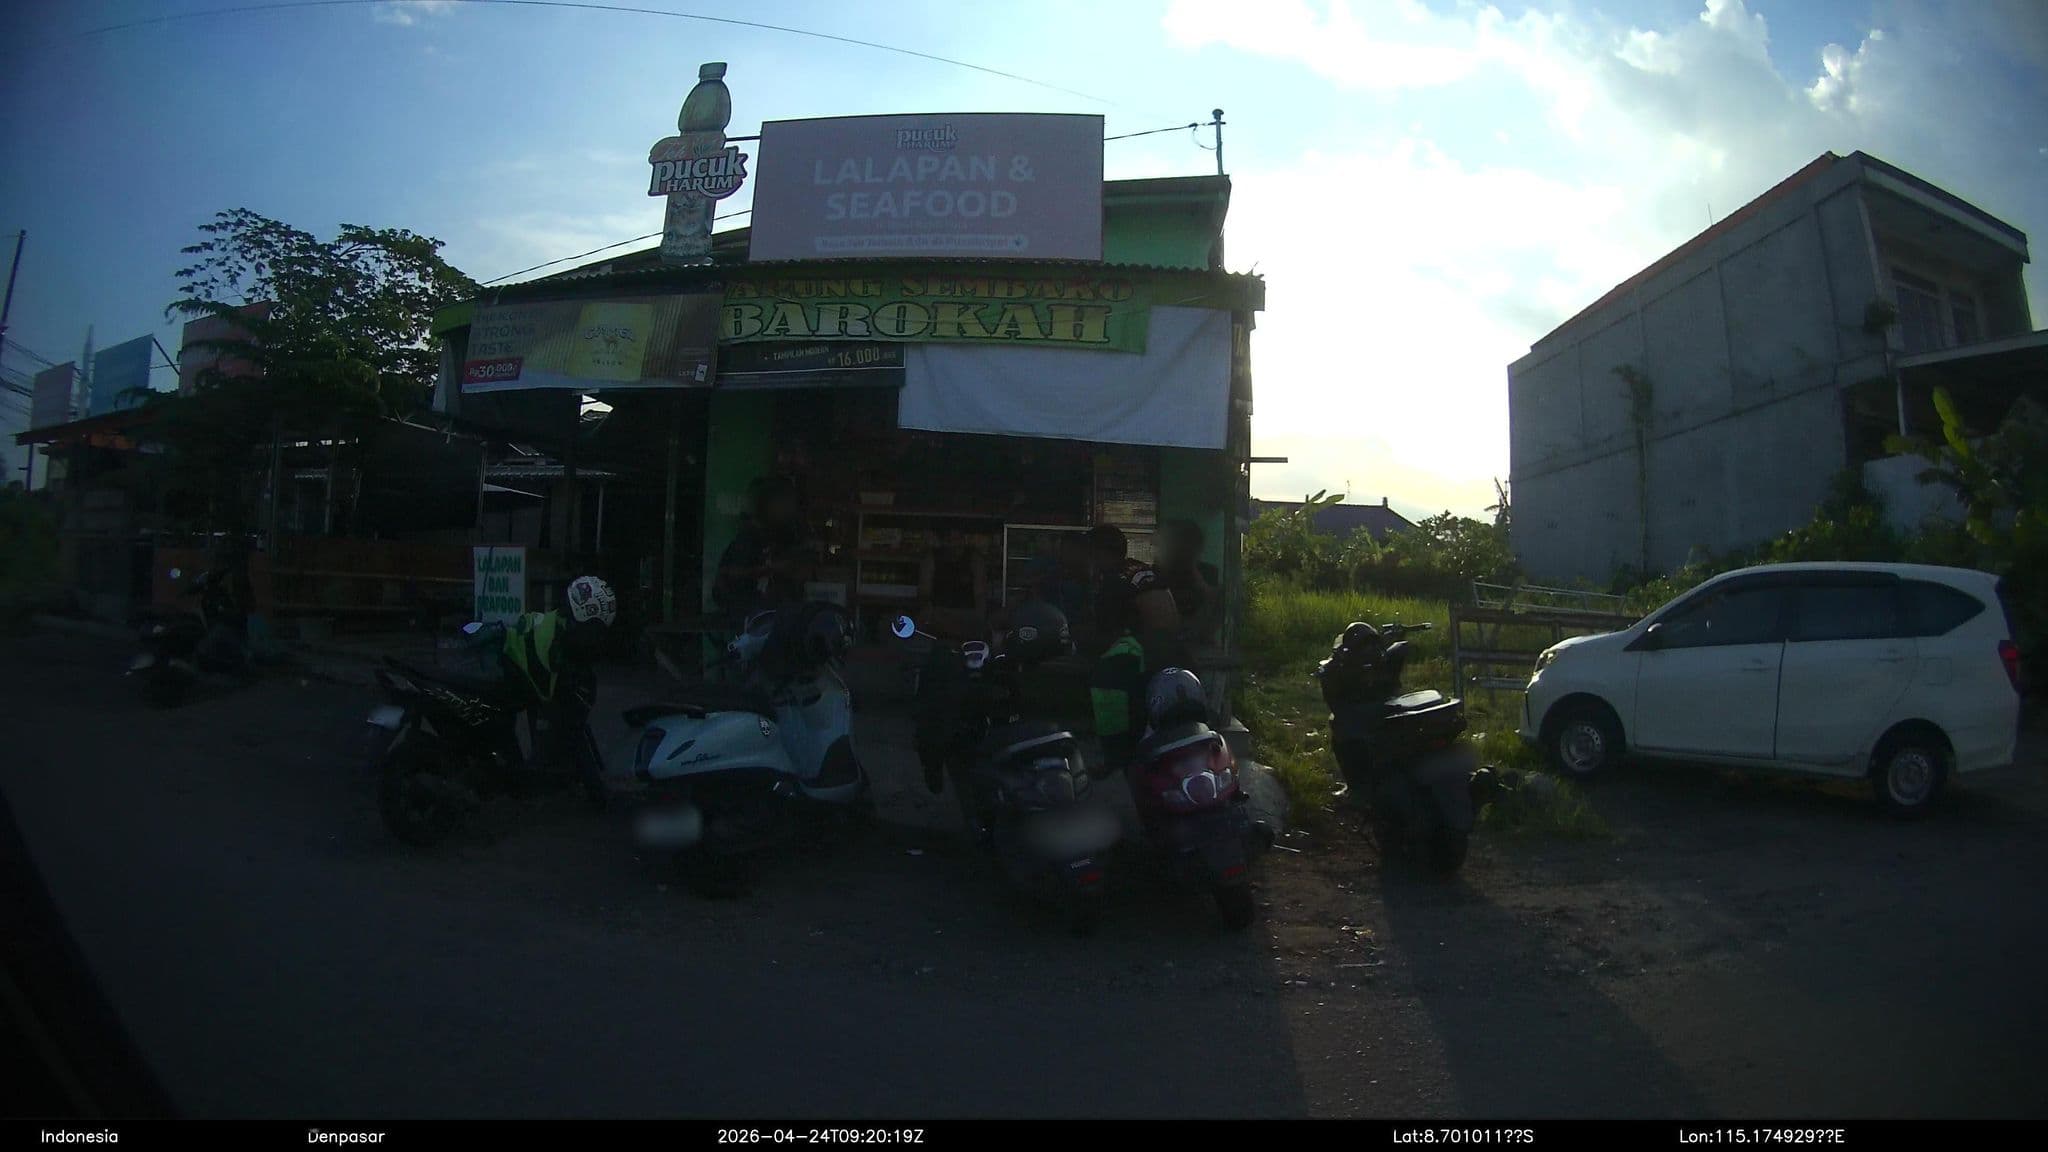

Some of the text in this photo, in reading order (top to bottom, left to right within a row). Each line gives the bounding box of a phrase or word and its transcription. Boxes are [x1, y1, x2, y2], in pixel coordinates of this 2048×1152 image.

[651, 147, 746, 193] pucuk
[814, 154, 1036, 185] LALAPAN &
[666, 176, 733, 192] HARUM
[826, 189, 1018, 220] SEAFOOD
[727, 279, 882, 298] ARUNG
[902, 278, 1135, 301] SEMBAKO
[722, 302, 1111, 342] BAROKAH
[838, 346, 881, 367] 16.000
[488, 576, 508, 592] DAN
